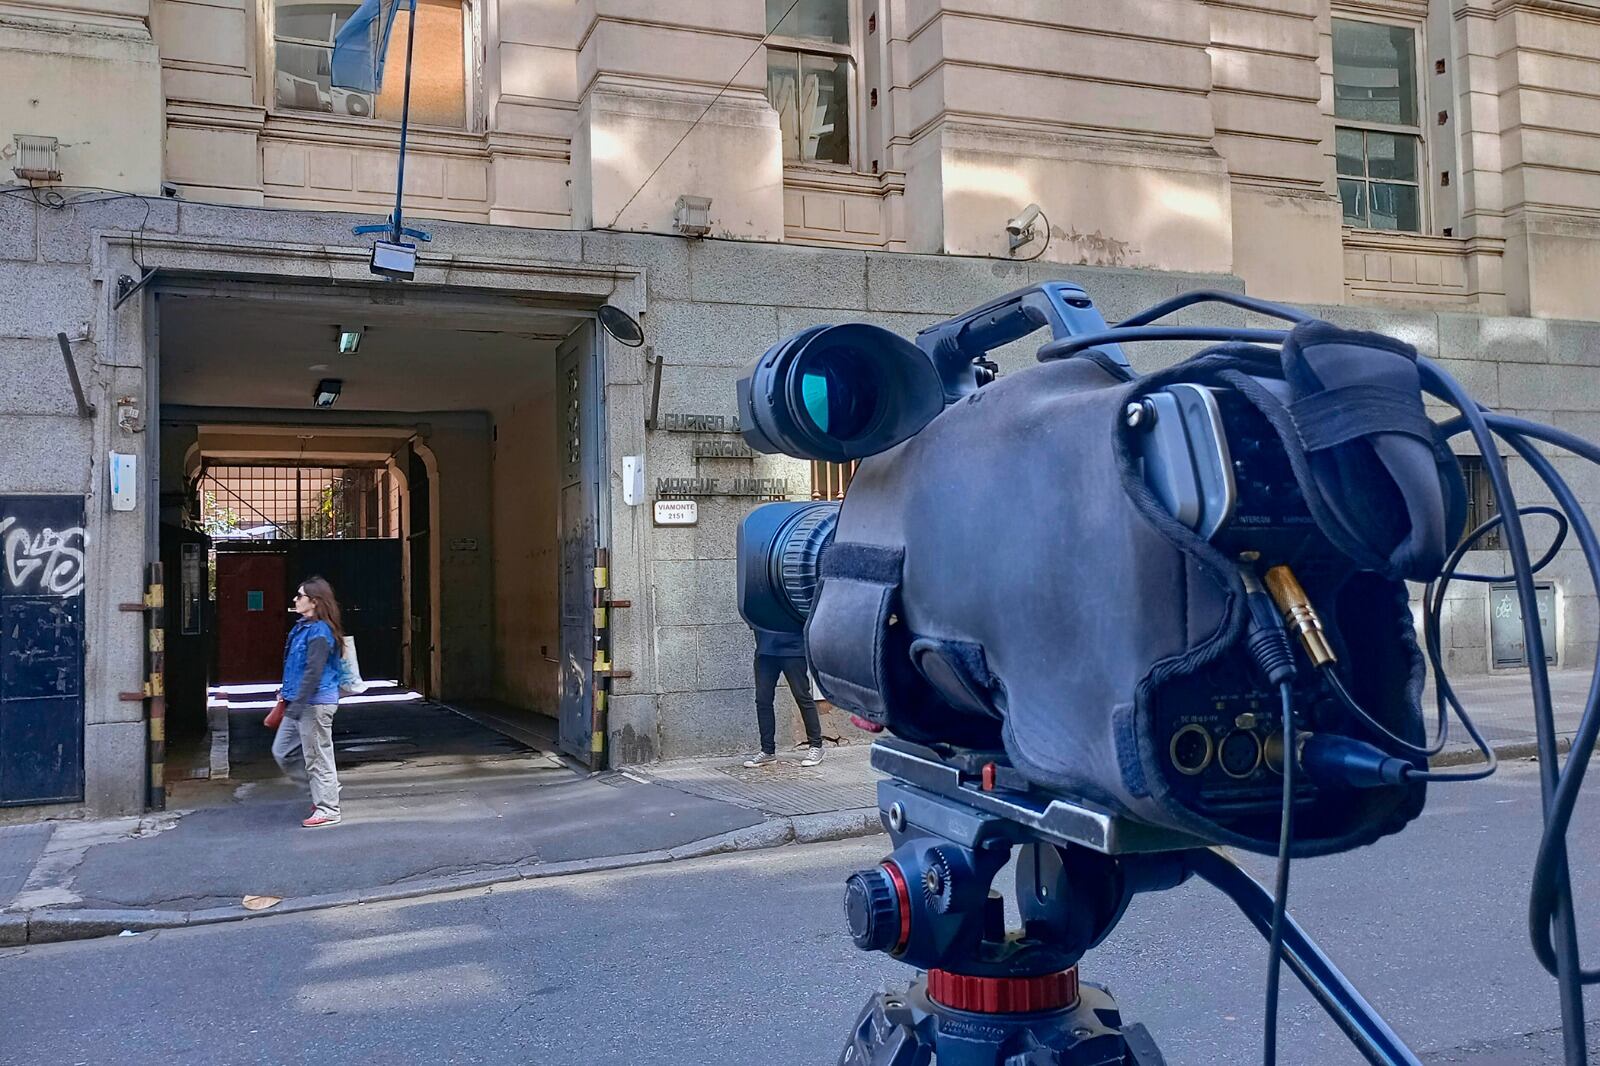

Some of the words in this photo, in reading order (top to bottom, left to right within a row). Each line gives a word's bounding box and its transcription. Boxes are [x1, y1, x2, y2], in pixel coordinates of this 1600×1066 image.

[664, 413, 725, 431] CUERPO
[692, 440, 755, 458] FORENS
[656, 477, 719, 495] MORGUE
[732, 478, 788, 495] JUDICIAL
[668, 512, 685, 520] 2151
